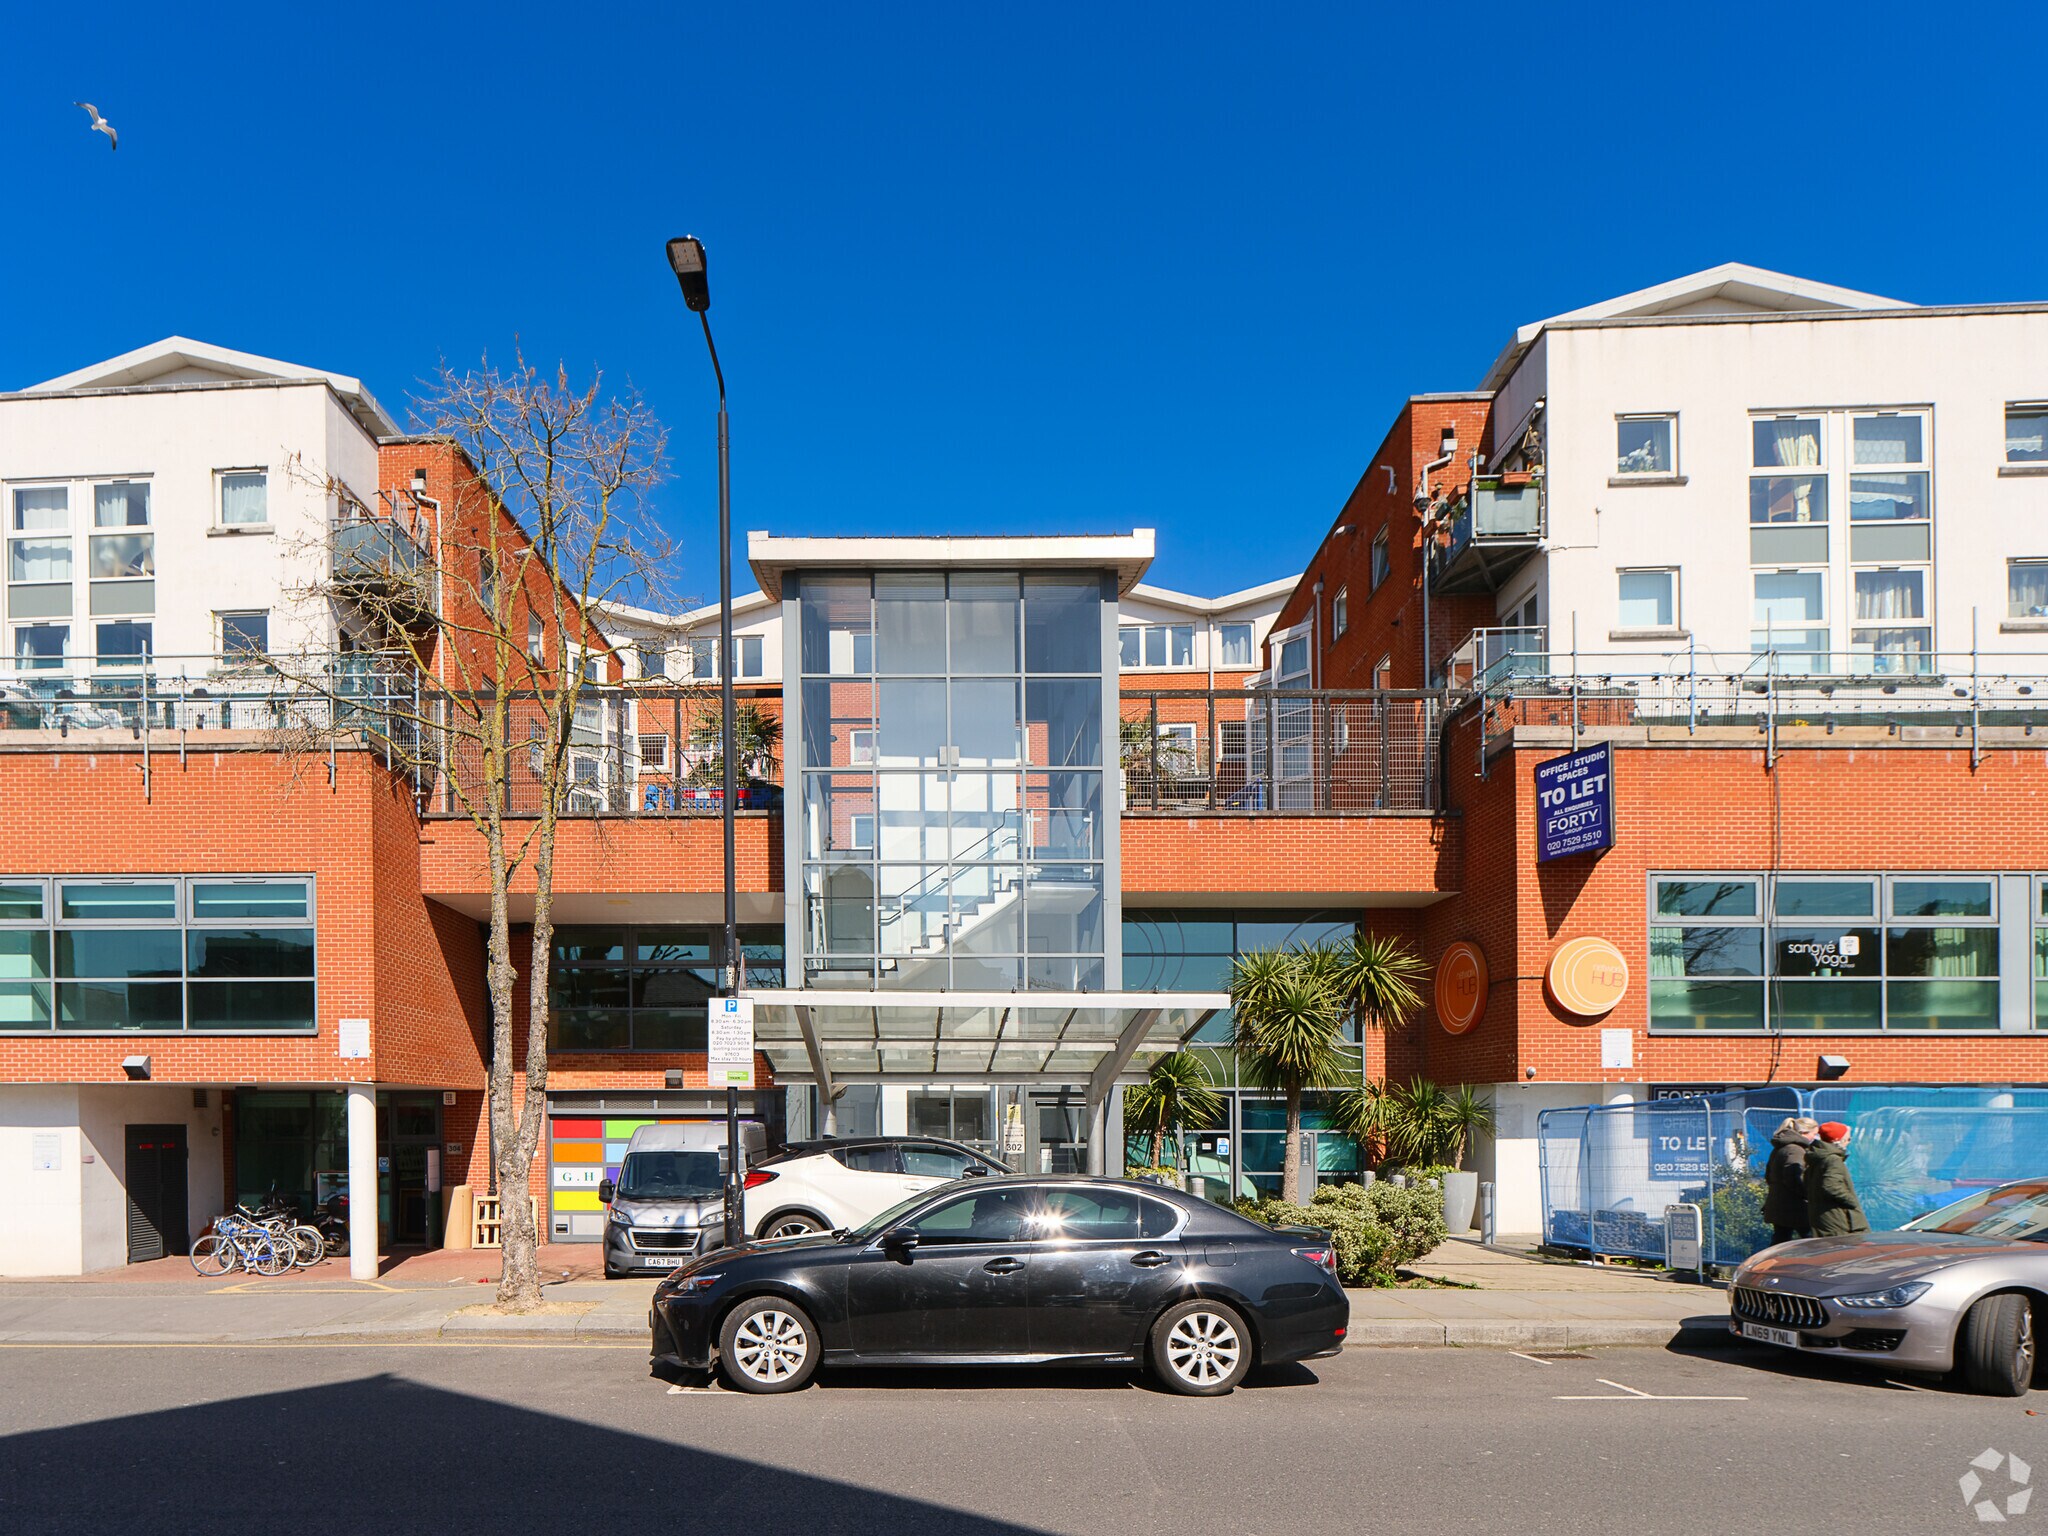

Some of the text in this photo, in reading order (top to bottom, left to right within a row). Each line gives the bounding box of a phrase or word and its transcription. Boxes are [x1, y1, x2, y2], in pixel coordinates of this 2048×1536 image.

[1540, 762, 1568, 778] OFFICE
[1574, 750, 1606, 767] STUDIO
[1557, 767, 1589, 783] SPACES
[1540, 774, 1606, 808] TO LET
[1564, 800, 1594, 813] ENQUIRIES
[1549, 808, 1599, 833] FORTY
[1564, 826, 1583, 835] GROUP
[1547, 830, 1602, 851] 020 7529 5510
[1788, 940, 1835, 956] sangyé
[1814, 954, 1848, 967] yoga
[1457, 977, 1476, 996] HUB
[1591, 970, 1624, 988] HUB
[1659, 1136, 1717, 1151] TO LET
[1654, 1164, 1673, 1172] 020
[1746, 1324, 1792, 1344] LN69 YNL
